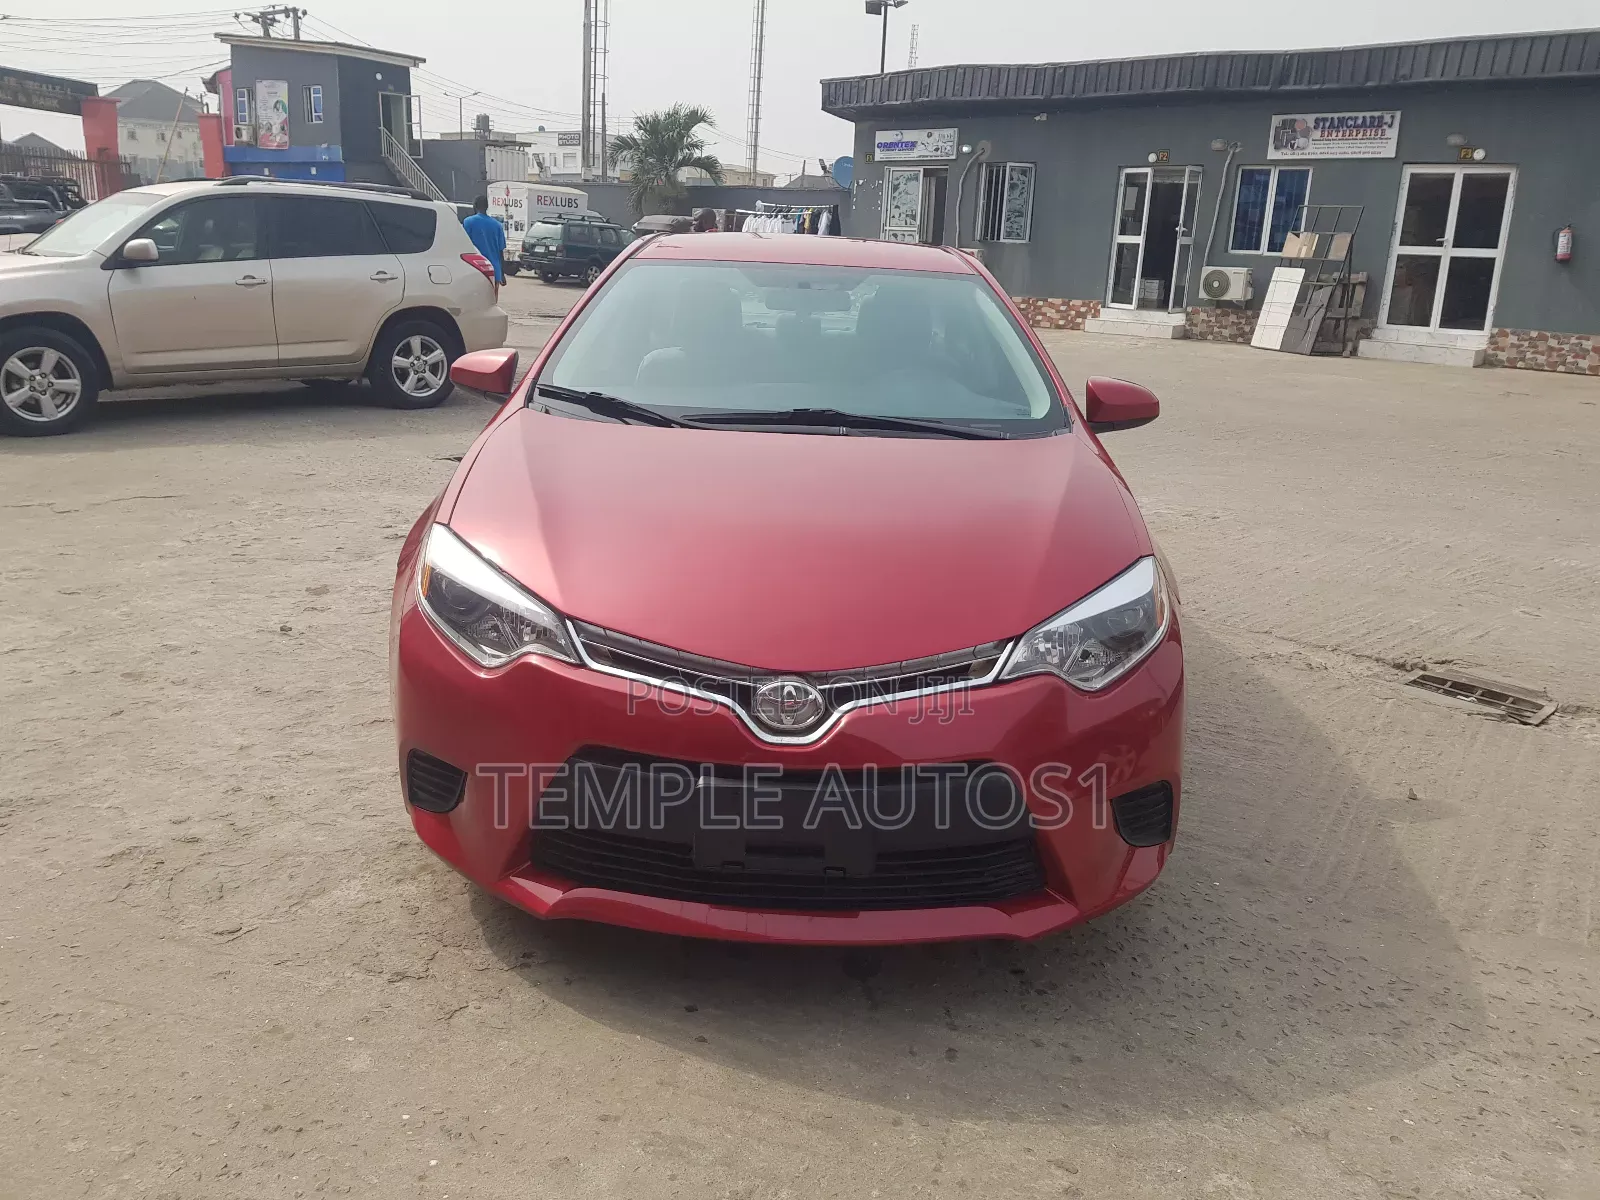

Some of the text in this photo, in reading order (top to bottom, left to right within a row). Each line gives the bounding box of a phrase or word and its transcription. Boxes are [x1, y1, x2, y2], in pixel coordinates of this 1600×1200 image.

[1320, 128, 1386, 138] ENTERPRISE
[492, 197, 523, 208] REXLUBS
[537, 195, 579, 208] REXLUBS
